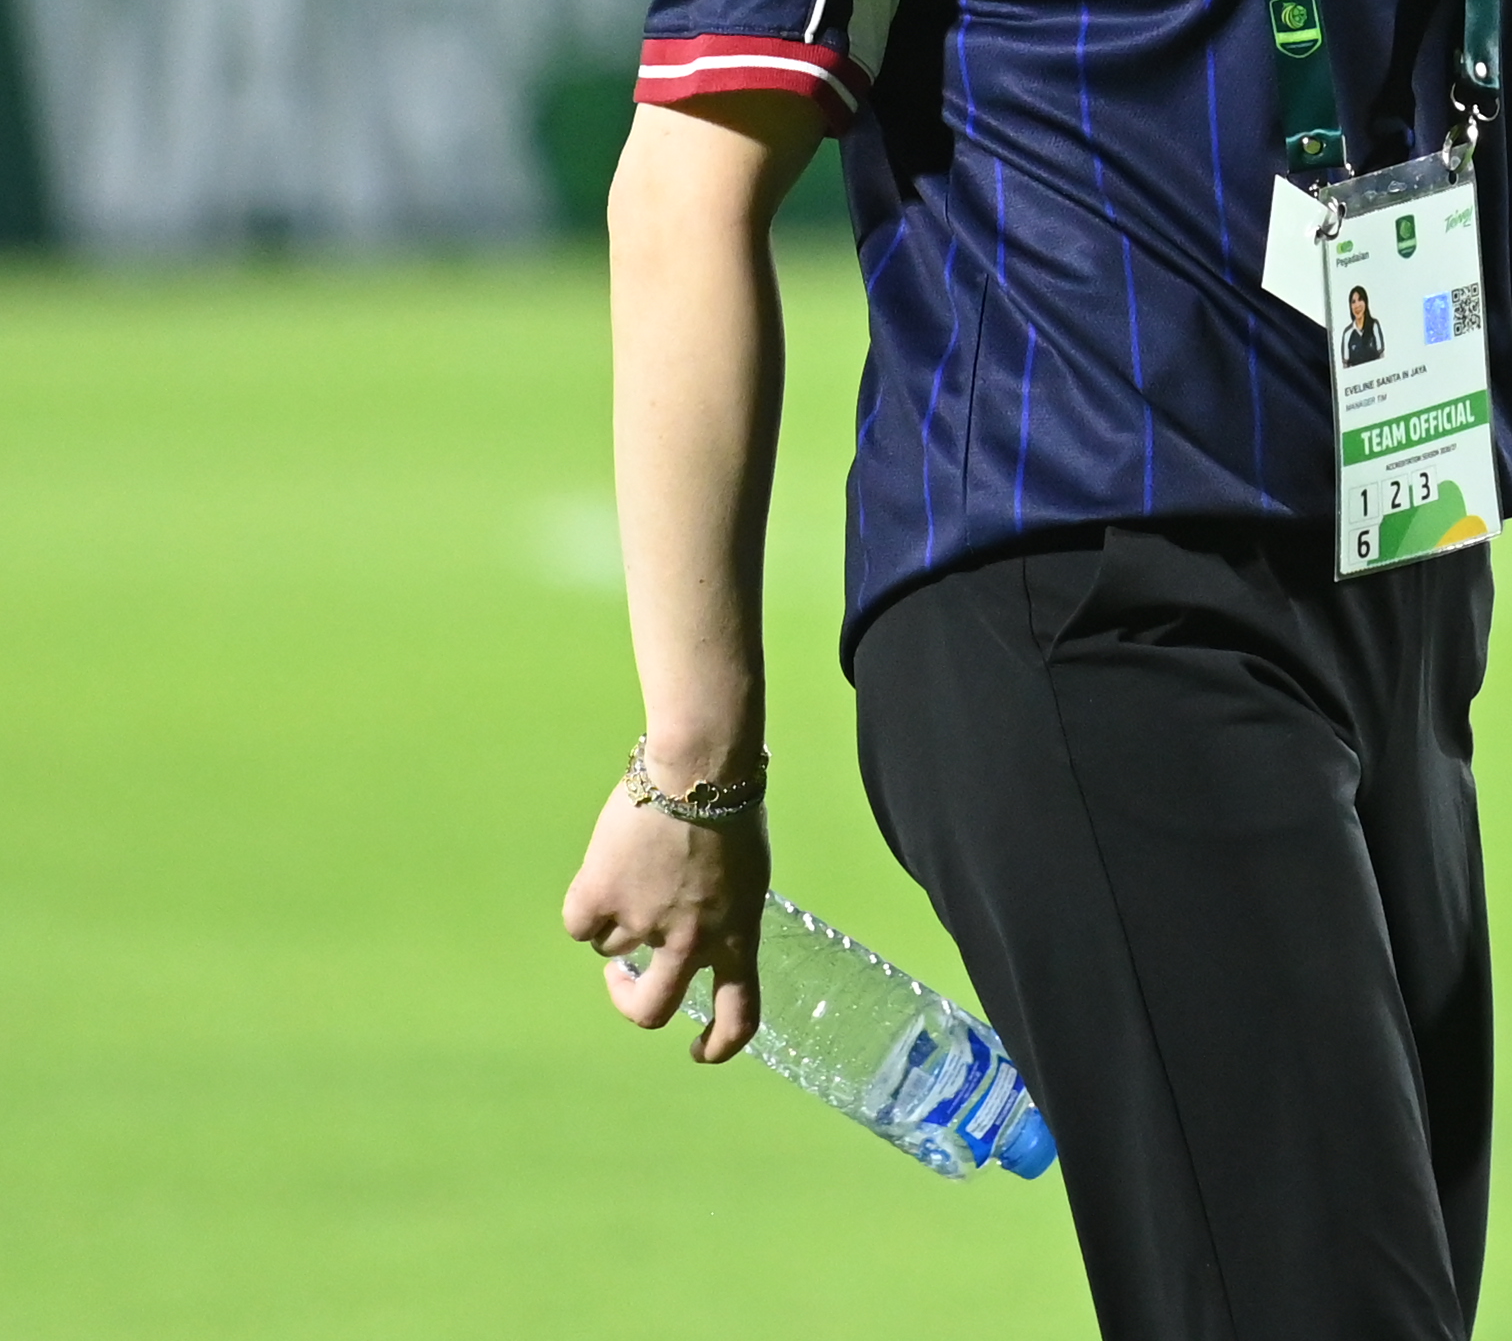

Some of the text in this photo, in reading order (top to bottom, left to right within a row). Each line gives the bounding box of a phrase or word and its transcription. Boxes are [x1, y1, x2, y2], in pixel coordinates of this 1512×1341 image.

[1344, 379, 1375, 397] EVELINE
[1375, 372, 1402, 388] SANITA
[1360, 399, 1476, 456] TEAM OFFICIAL
[1360, 471, 1431, 517] 1 2 3
[1357, 529, 1371, 559] 6
